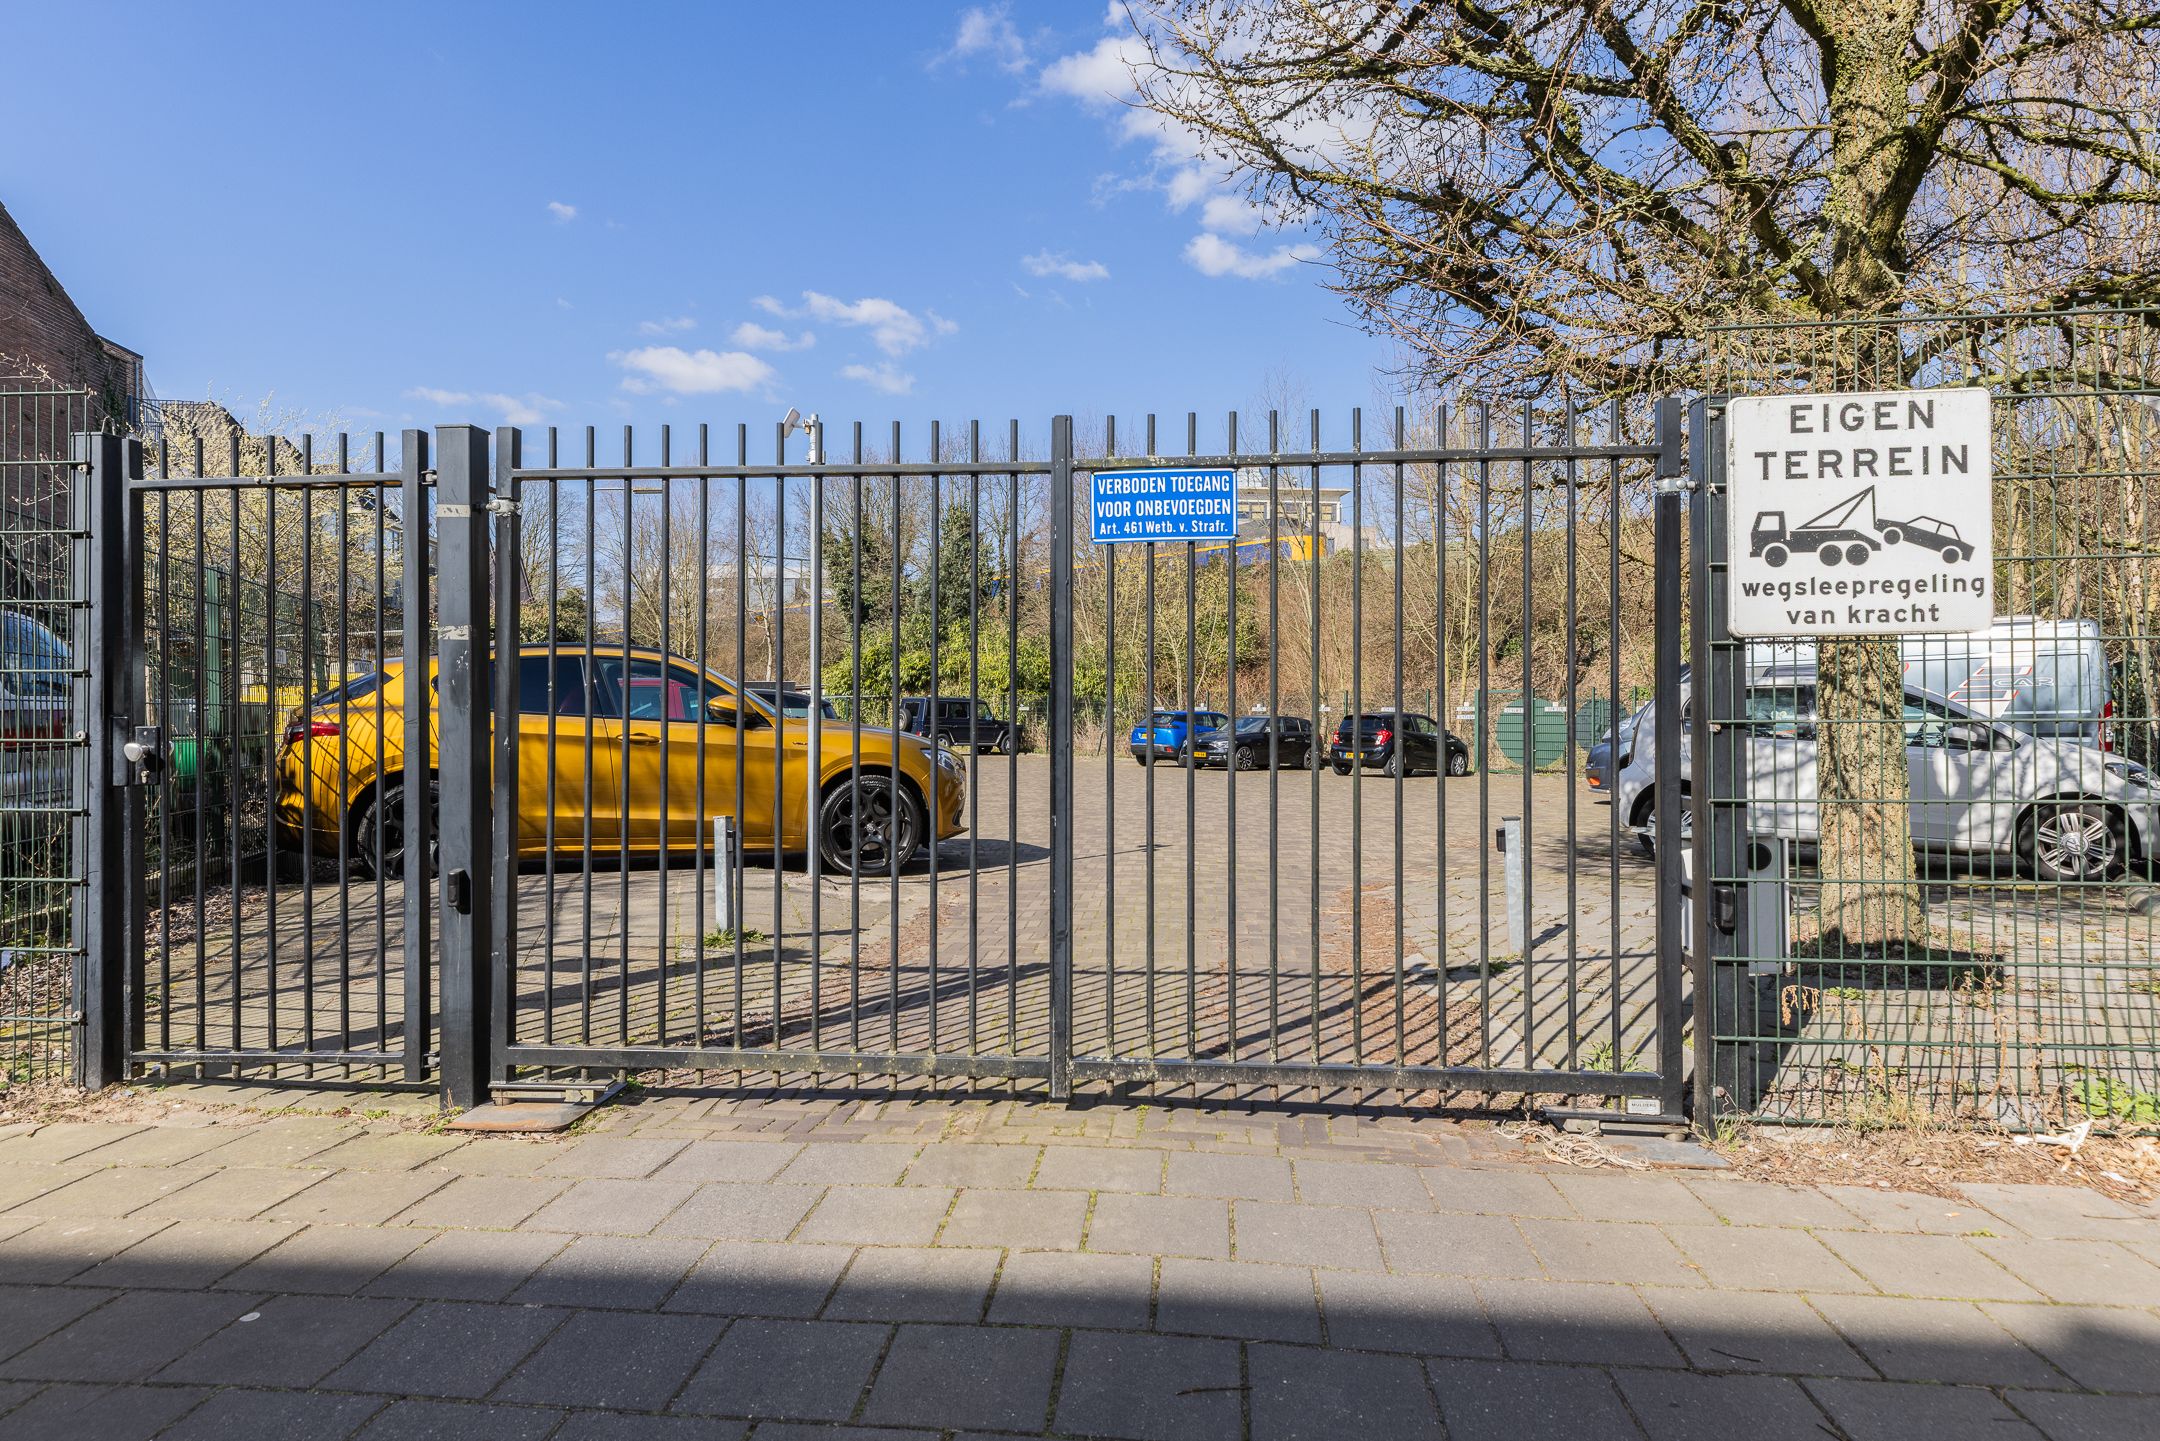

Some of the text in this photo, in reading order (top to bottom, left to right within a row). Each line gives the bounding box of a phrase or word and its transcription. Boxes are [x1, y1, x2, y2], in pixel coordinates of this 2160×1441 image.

[1791, 400, 1933, 433] EIGEN
[1755, 445, 1968, 480] TERREIN
[1097, 475, 1230, 494] VERBODEN TOEGANG
[1097, 499, 1231, 517] VOOR ONBEVOEGDEN
[1099, 519, 1228, 534] Art. 461 Wetb. v. Strafr.
[1742, 574, 1985, 602] wegsleepregeling
[1787, 604, 1939, 625] van kracht
[1992, 677, 2054, 688] CAR
